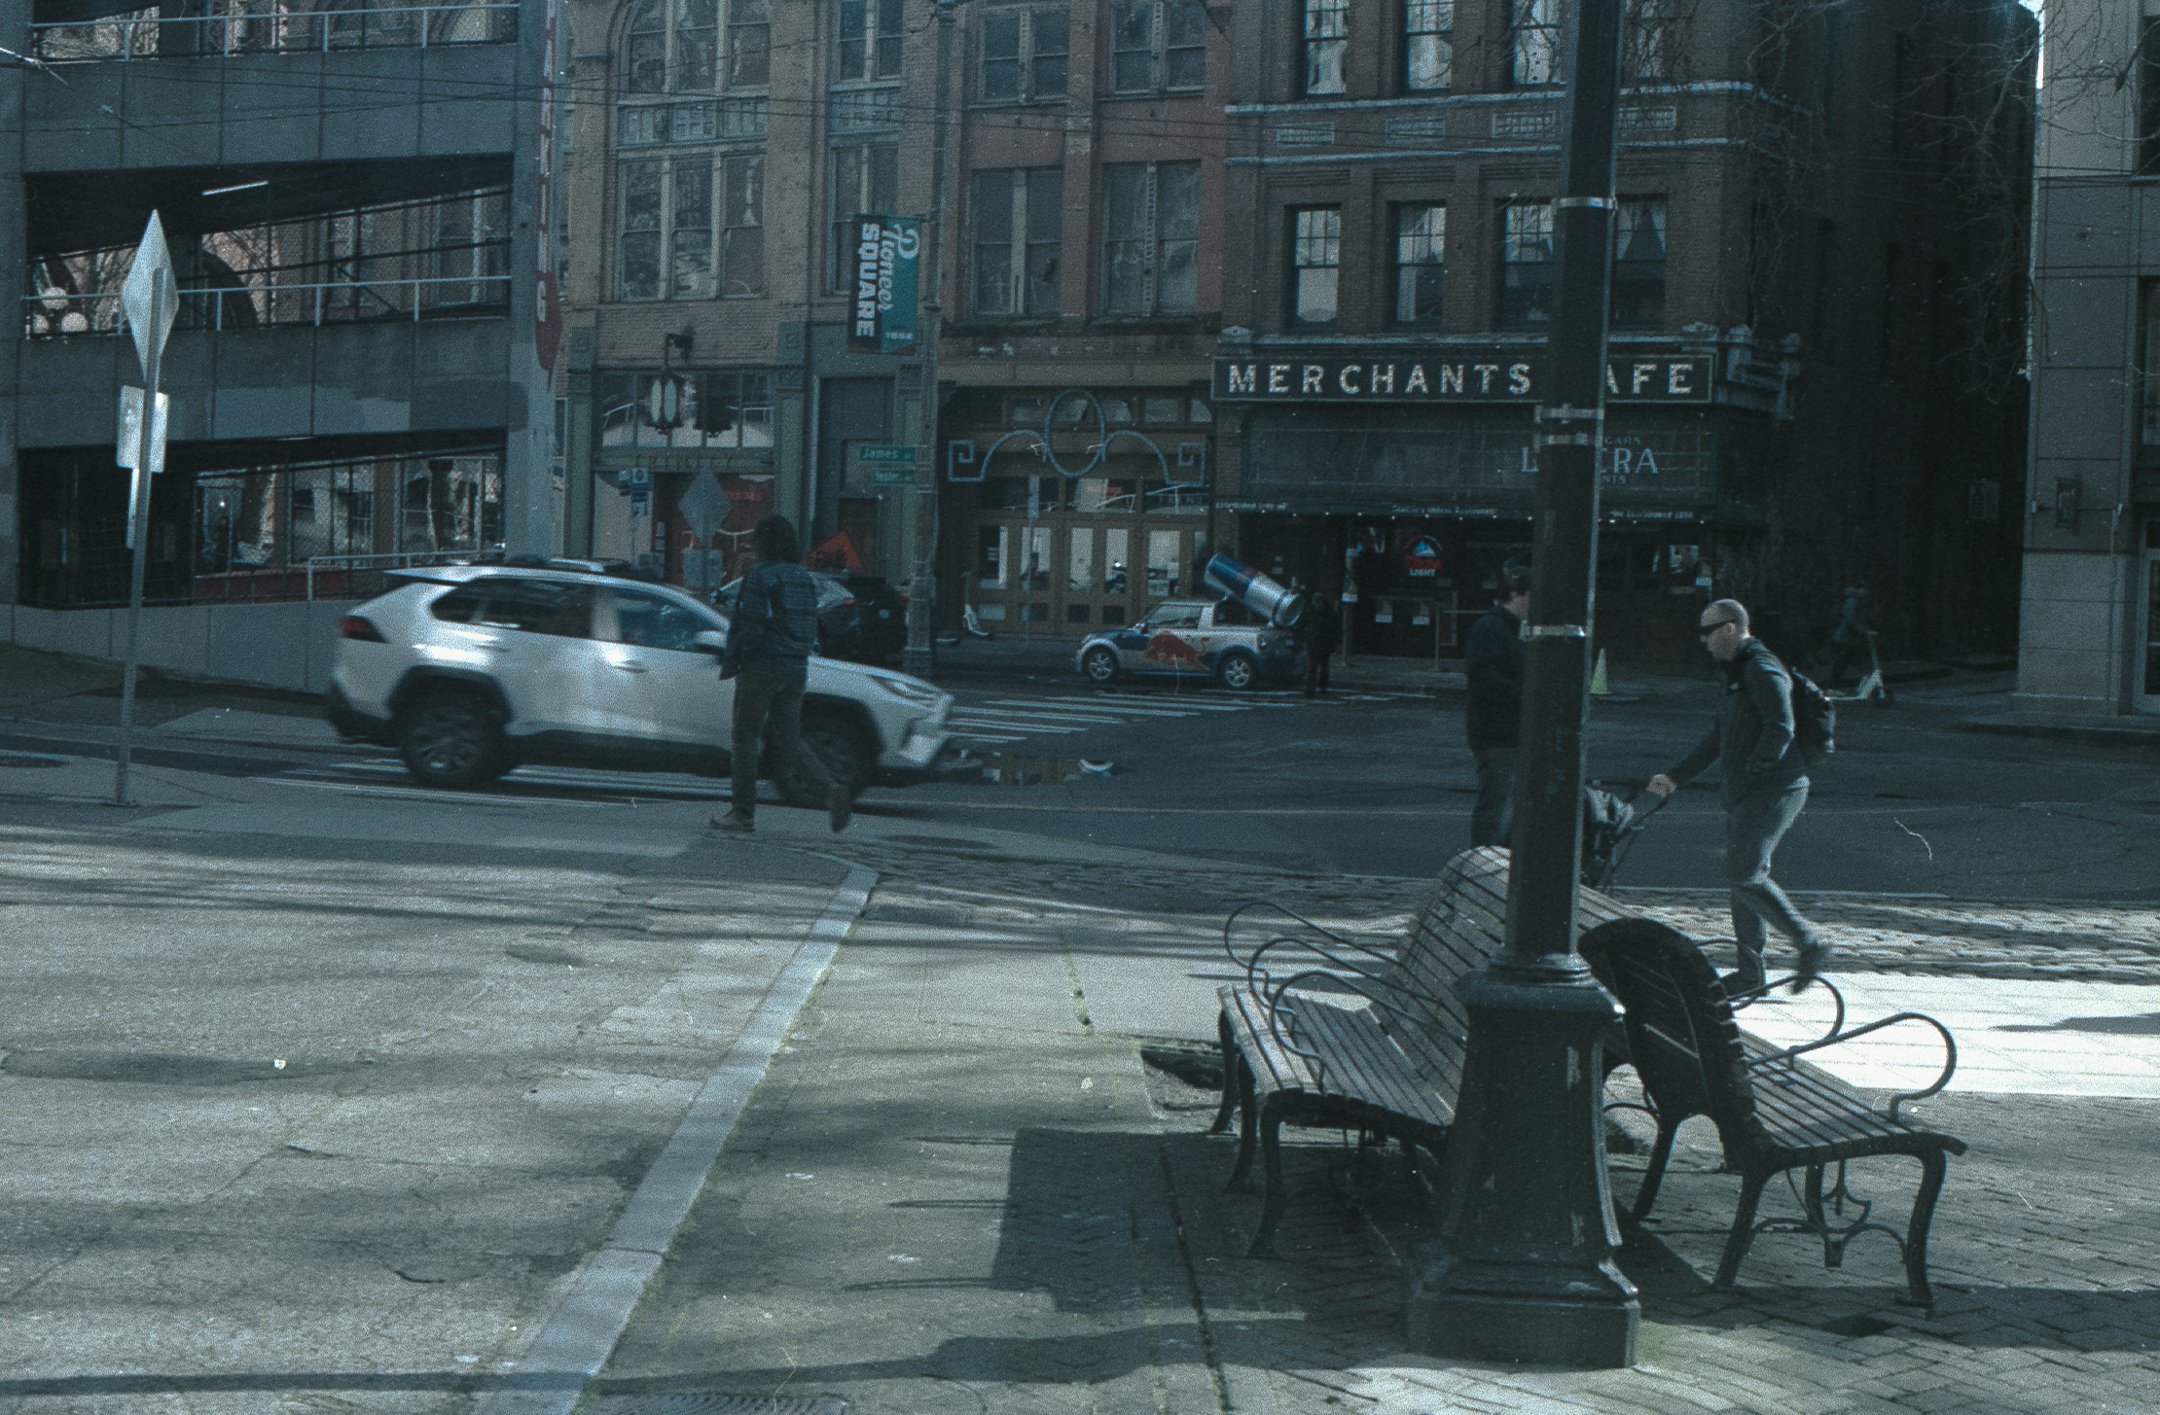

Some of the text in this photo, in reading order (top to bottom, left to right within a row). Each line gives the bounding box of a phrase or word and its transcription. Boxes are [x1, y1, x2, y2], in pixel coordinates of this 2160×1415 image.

[855, 222, 881, 338] SQUARE
[876, 223, 921, 313] Pioneer
[1227, 363, 1533, 395] MERCHANTS
[862, 446, 898, 459] James
